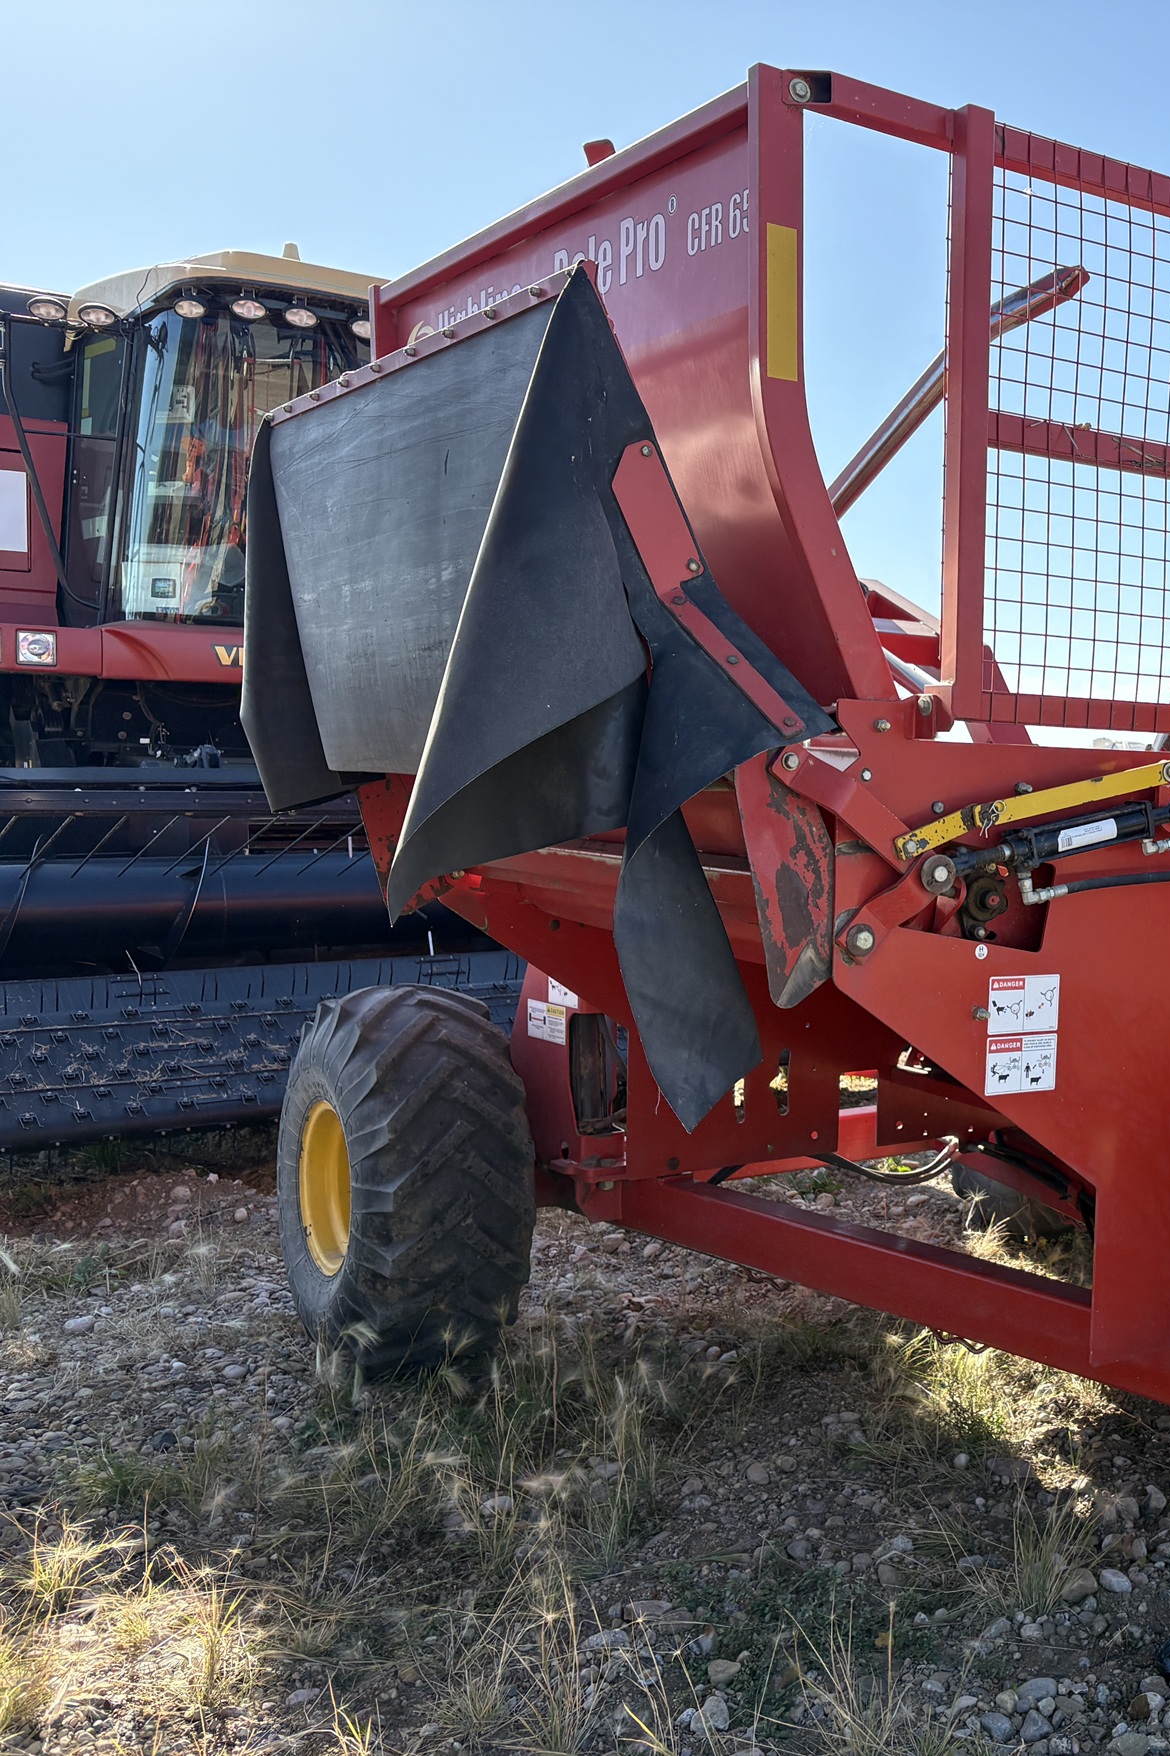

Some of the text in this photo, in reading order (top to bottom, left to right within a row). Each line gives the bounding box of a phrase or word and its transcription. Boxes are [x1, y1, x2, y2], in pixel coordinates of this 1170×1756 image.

[687, 202, 723, 257] CFR
[999, 980, 1024, 988] DANGER
[996, 1041, 1021, 1049] DANGER
